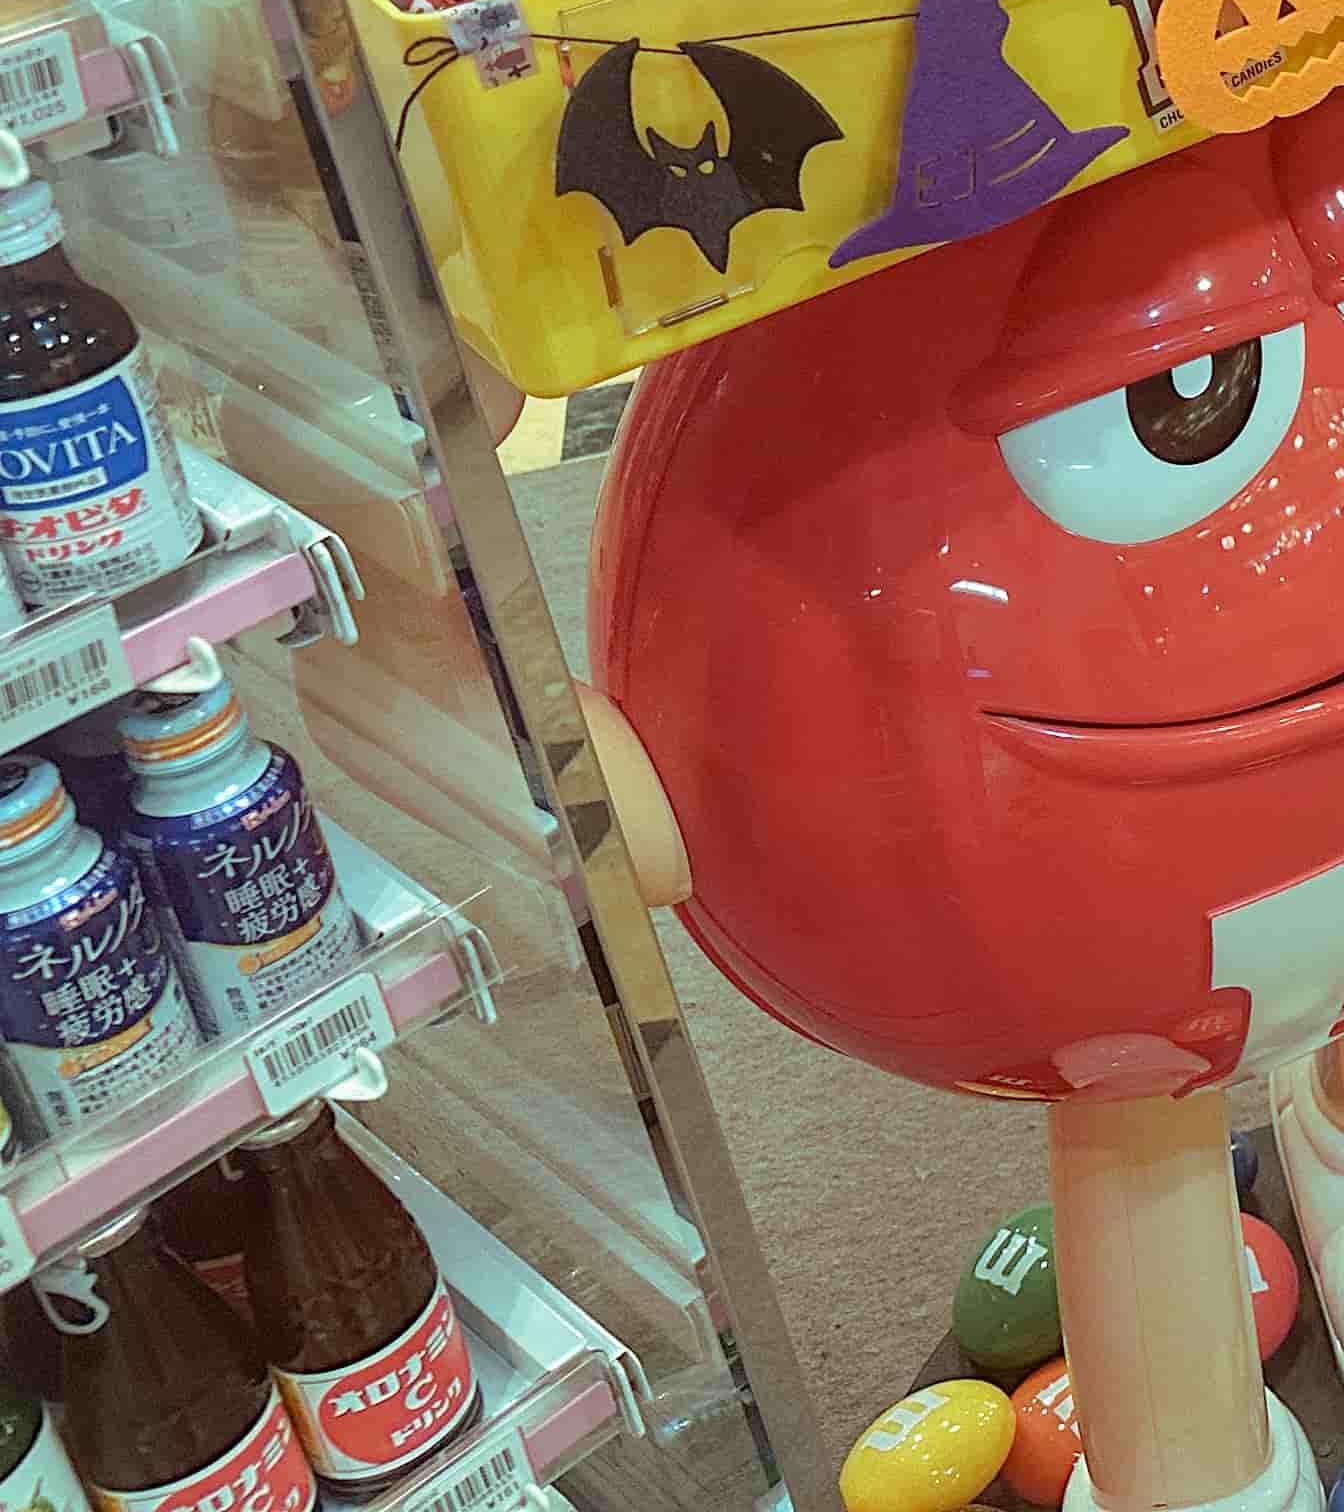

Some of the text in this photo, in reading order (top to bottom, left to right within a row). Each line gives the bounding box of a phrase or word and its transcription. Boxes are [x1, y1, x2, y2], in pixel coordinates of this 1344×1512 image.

[1229, 49, 1284, 89] CANDIES
[26, 529, 124, 563] ドリンク
[237, 877, 323, 943] 疲労感
[57, 979, 156, 1049] 疲労感
[975, 1226, 1049, 1294] m
[390, 1375, 464, 1450] ドリンク
[862, 1378, 946, 1452] m
